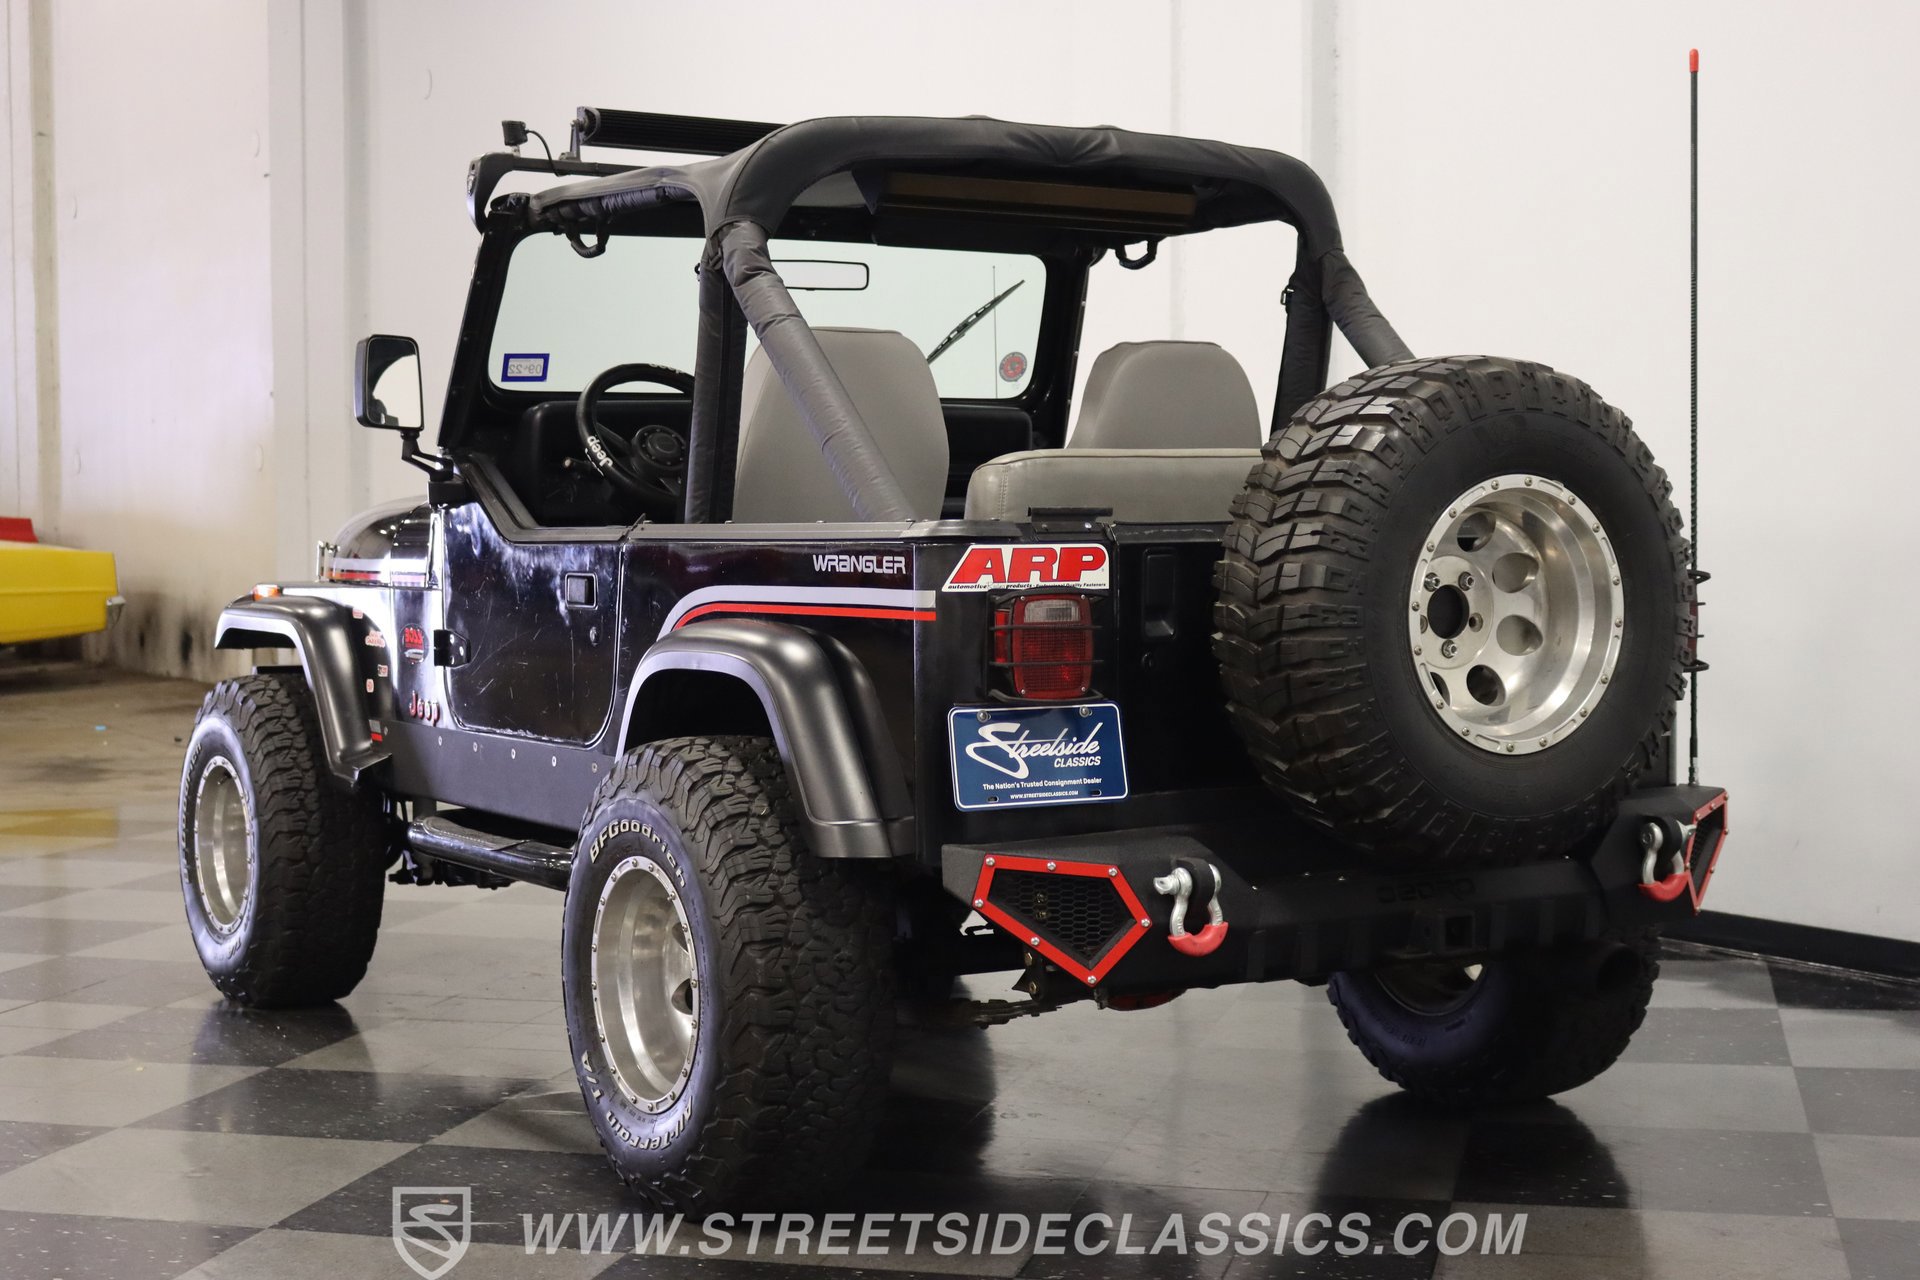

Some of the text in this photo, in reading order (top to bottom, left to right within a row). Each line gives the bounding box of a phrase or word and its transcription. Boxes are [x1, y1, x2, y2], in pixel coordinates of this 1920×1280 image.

[587, 436, 613, 467] Jeep
[950, 547, 1107, 584] ARP
[409, 690, 440, 727] Jeep
[965, 722, 1103, 779] Streetside
[1054, 756, 1102, 768] CLASSICS
[995, 781, 1020, 790] Nation's
[1020, 780, 1043, 788] Trusted
[1044, 778, 1082, 787] Consignment
[590, 819, 686, 888] BFGoodrich
[606, 1096, 693, 1151] All-Terrain
